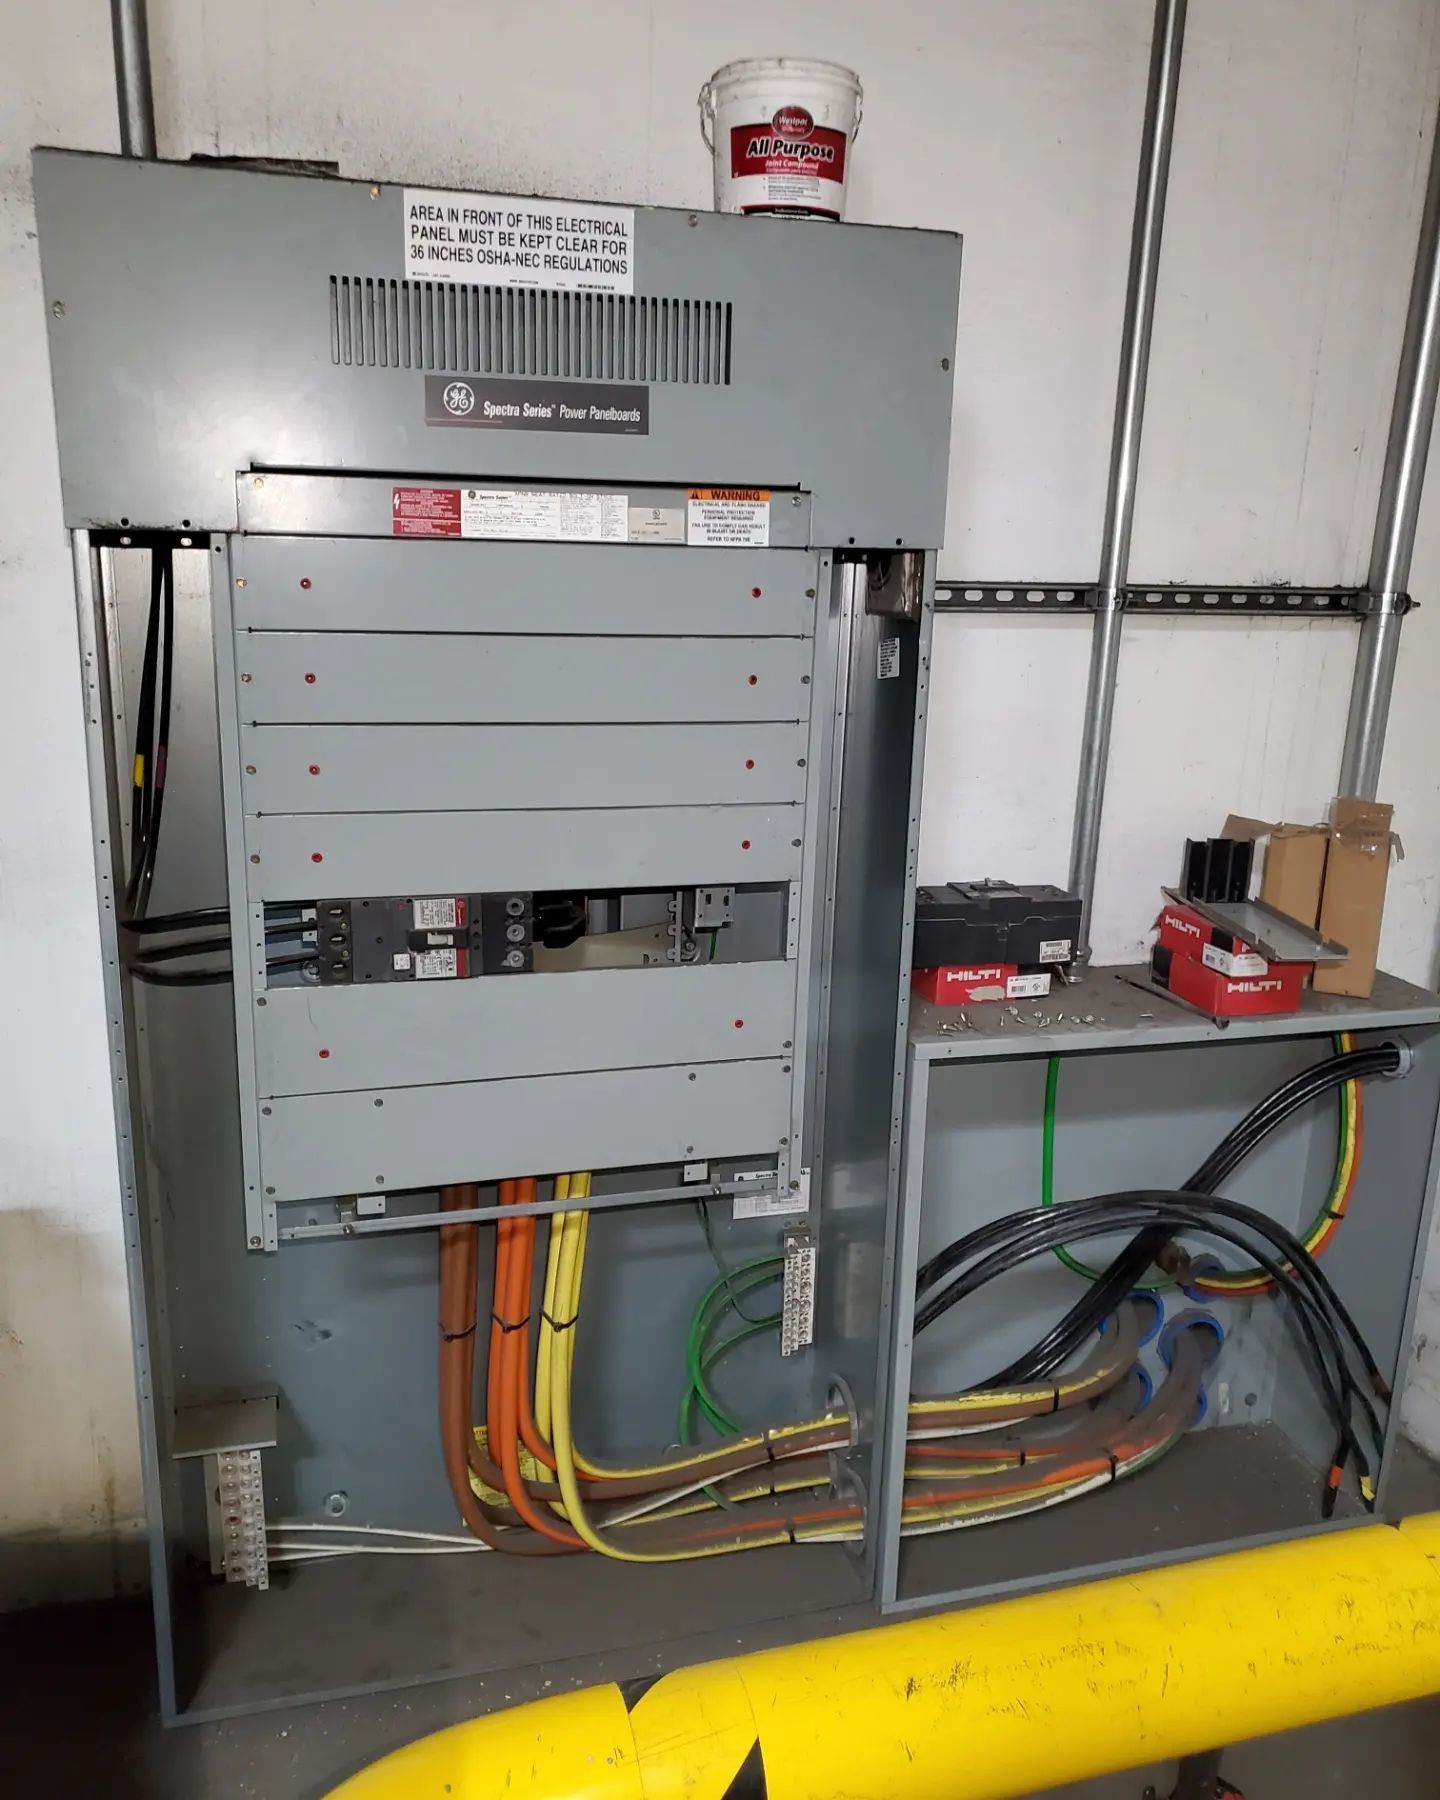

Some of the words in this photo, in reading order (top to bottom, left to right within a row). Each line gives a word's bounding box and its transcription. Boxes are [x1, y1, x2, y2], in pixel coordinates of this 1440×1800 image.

[747, 138, 770, 157] All
[771, 138, 833, 161] Purpose
[766, 159, 782, 168] Joint
[783, 160, 819, 170] Compound
[410, 204, 444, 222] AREA
[448, 207, 459, 223] IN
[463, 208, 503, 227] FRONT
[507, 212, 523, 228] OF
[526, 214, 552, 231] THIS
[556, 216, 628, 237] ELECTRICAL
[411, 224, 455, 242] PANEL
[458, 228, 494, 245] MUST
[498, 231, 515, 247] BE
[519, 233, 552, 250] KEPT
[556, 236, 598, 254] CLEAR
[602, 239, 627, 256] FOR
[410, 244, 424, 260] 36
[428, 245, 474, 263] INCHES
[477, 248, 540, 268] OSHA-NEC
[544, 254, 628, 275] REGULATIONS
[483, 400, 520, 418] Spectra
[559, 403, 587, 419] Power
[589, 405, 641, 422] Panelboards
[711, 490, 760, 501] WARNING
[1165, 914, 1200, 938] HILTI
[947, 968, 1001, 982] HILTI
[1227, 980, 1282, 993] HILTI
